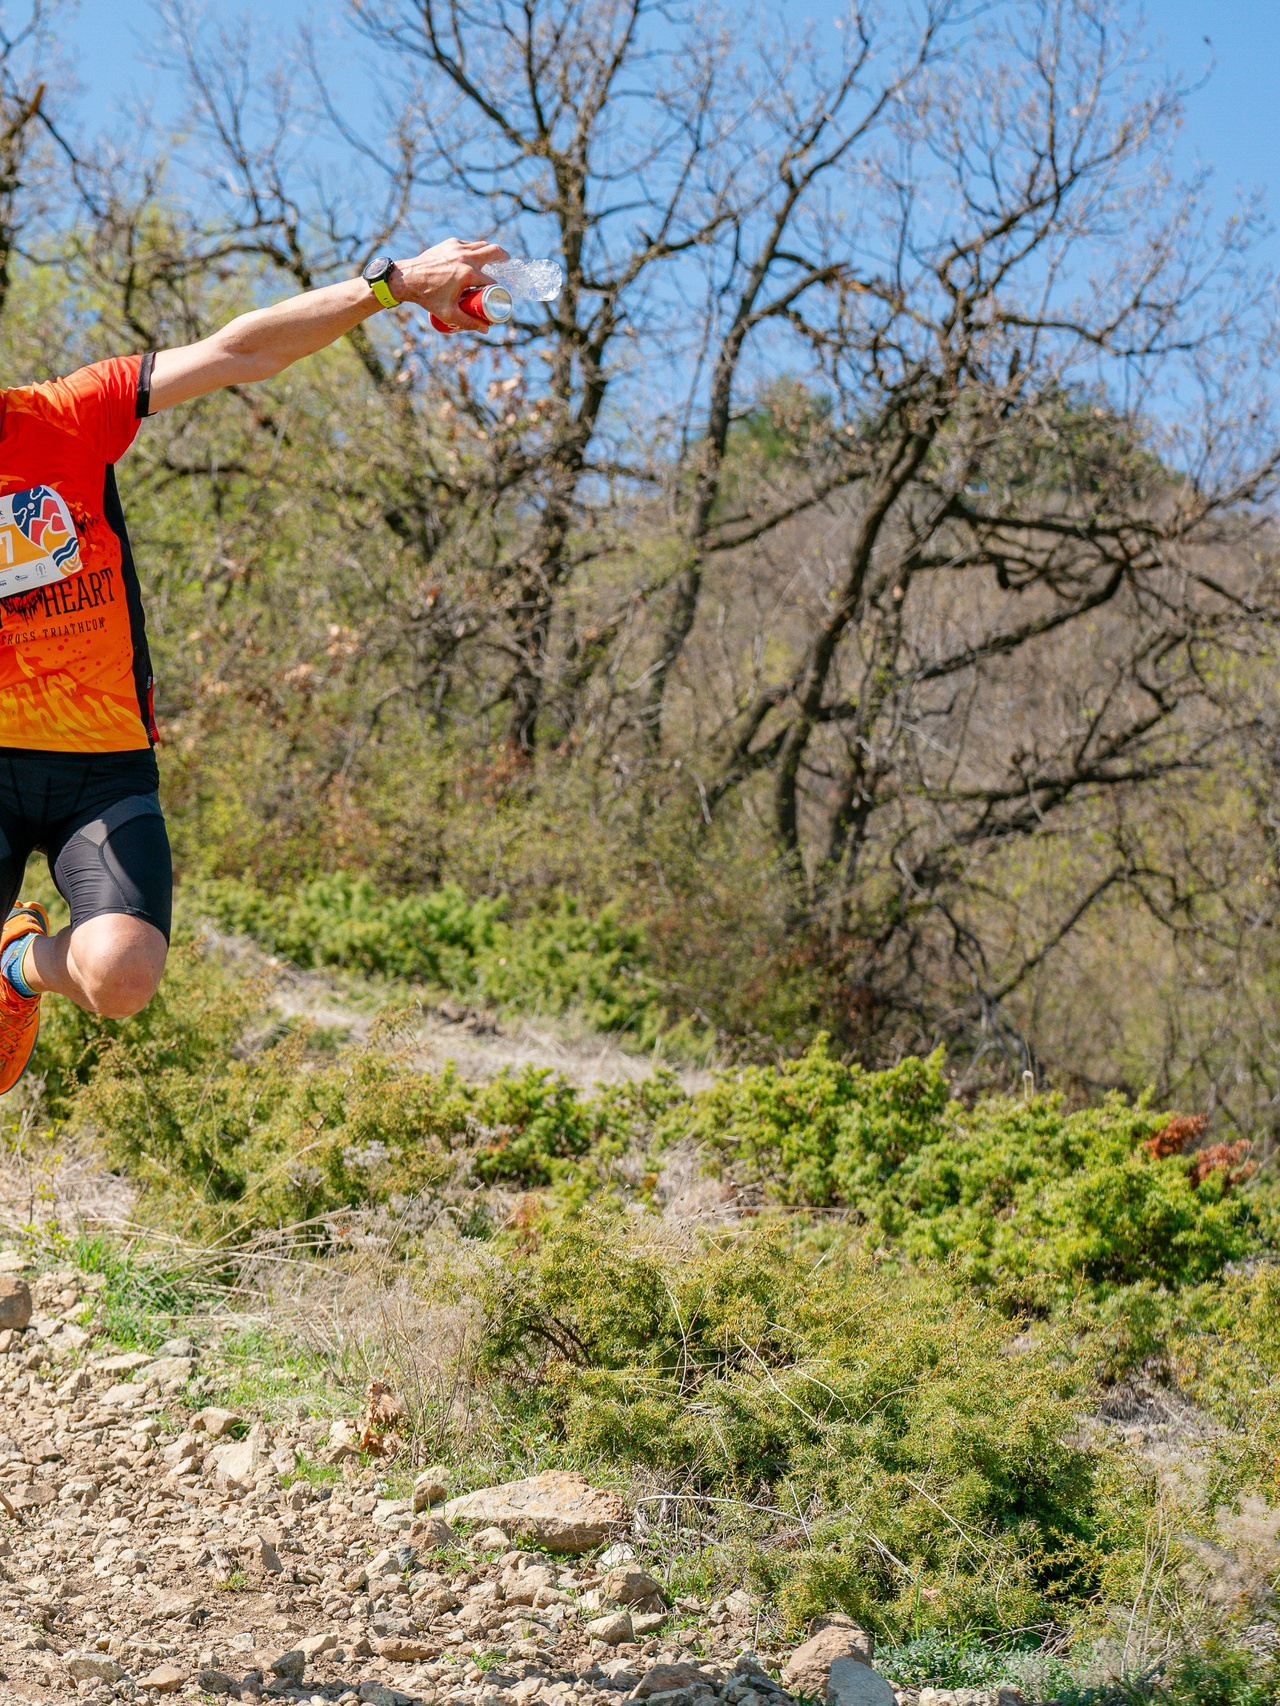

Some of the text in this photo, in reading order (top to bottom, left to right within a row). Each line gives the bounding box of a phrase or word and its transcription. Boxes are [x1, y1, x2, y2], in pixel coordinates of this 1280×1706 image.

[41, 567, 115, 618] HEART
[1, 630, 37, 646] CROSS
[42, 616, 105, 639] TRIATHLON
